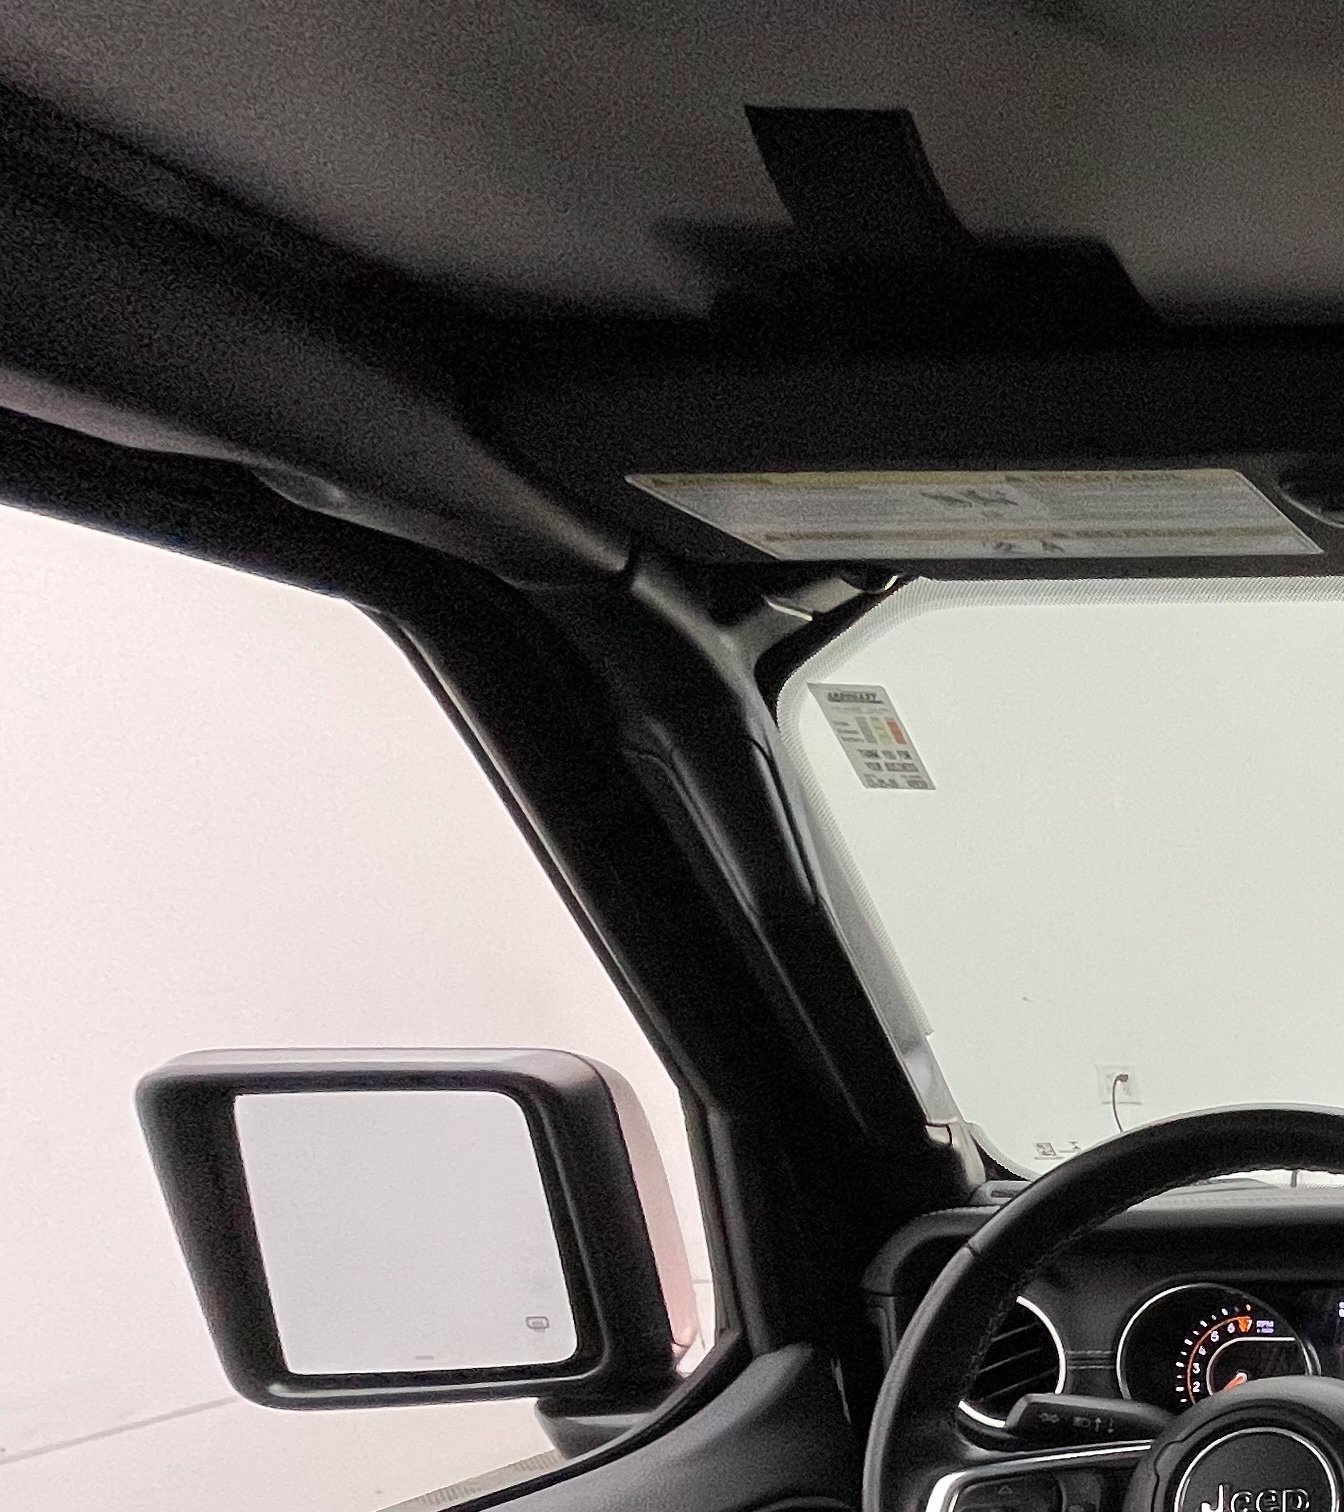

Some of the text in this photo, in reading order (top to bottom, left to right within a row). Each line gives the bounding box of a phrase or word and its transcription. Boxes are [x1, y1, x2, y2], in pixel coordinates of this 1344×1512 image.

[1227, 1322, 1236, 1334] 6
[1192, 1362, 1200, 1374] 3
[1192, 1380, 1201, 1393] 2
